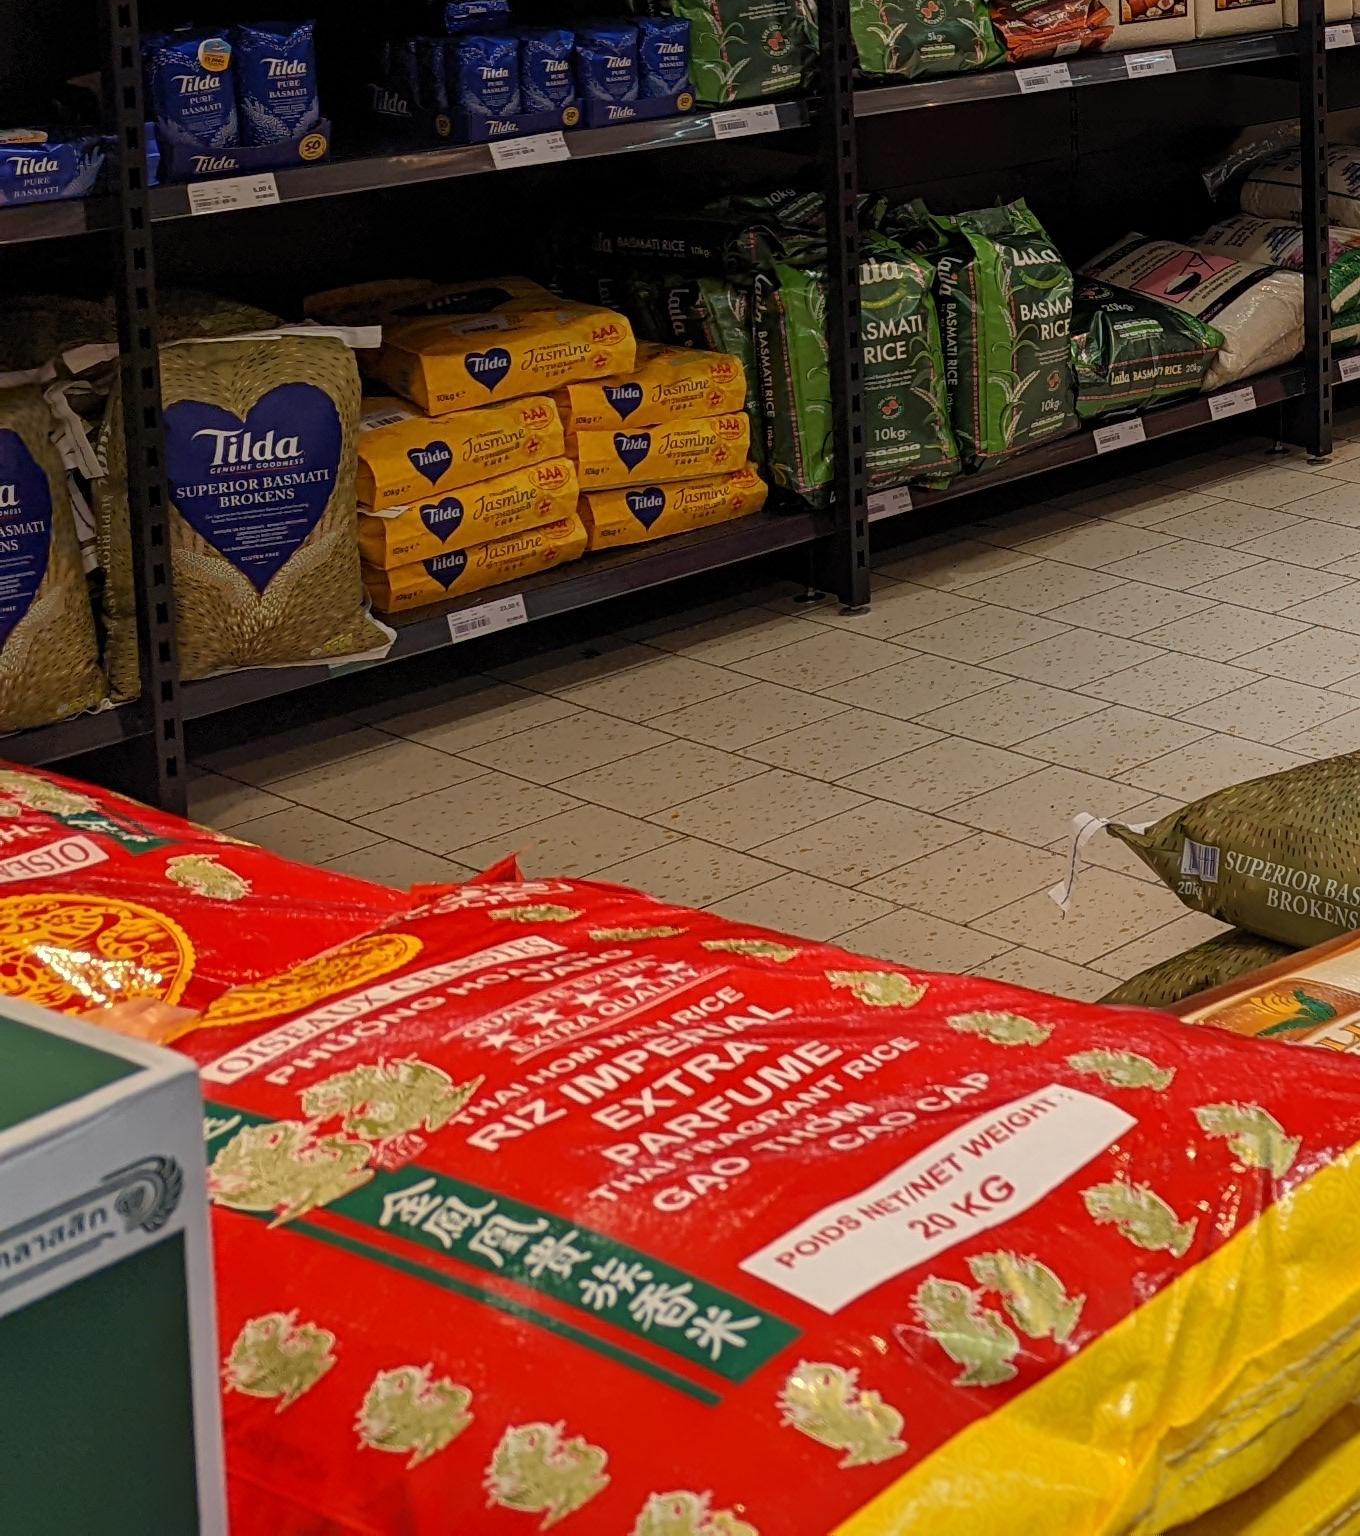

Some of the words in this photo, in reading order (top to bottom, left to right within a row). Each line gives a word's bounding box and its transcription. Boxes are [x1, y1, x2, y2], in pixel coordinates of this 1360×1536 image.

[927, 32, 942, 43] 5kg
[592, 324, 619, 341] AAA
[468, 355, 508, 373] Tilda
[521, 341, 592, 371] Jasmine
[191, 429, 303, 466] Tilda
[176, 479, 259, 499] SUPERIOR
[263, 469, 330, 488] BASMATI
[220, 488, 295, 508] BROKENS
[1224, 850, 1321, 898] SUPERIOR
[1266, 886, 1360, 931] BROKENS
[466, 1098, 568, 1152] RIZ
[559, 1004, 794, 1105] IMPERIAL
[592, 1039, 769, 1131] EXTRA
[589, 1152, 677, 1204] THAI
[676, 1075, 845, 1164] FRAGRANT
[841, 1035, 919, 1081] RICE
[601, 1038, 844, 1168] PARFUME
[775, 1213, 862, 1270] POIDS
[858, 1154, 964, 1223] NET/NET
[962, 1098, 1054, 1159] WEIGHT
[907, 1212, 959, 1241] 20
[963, 1174, 1016, 1218] KG
